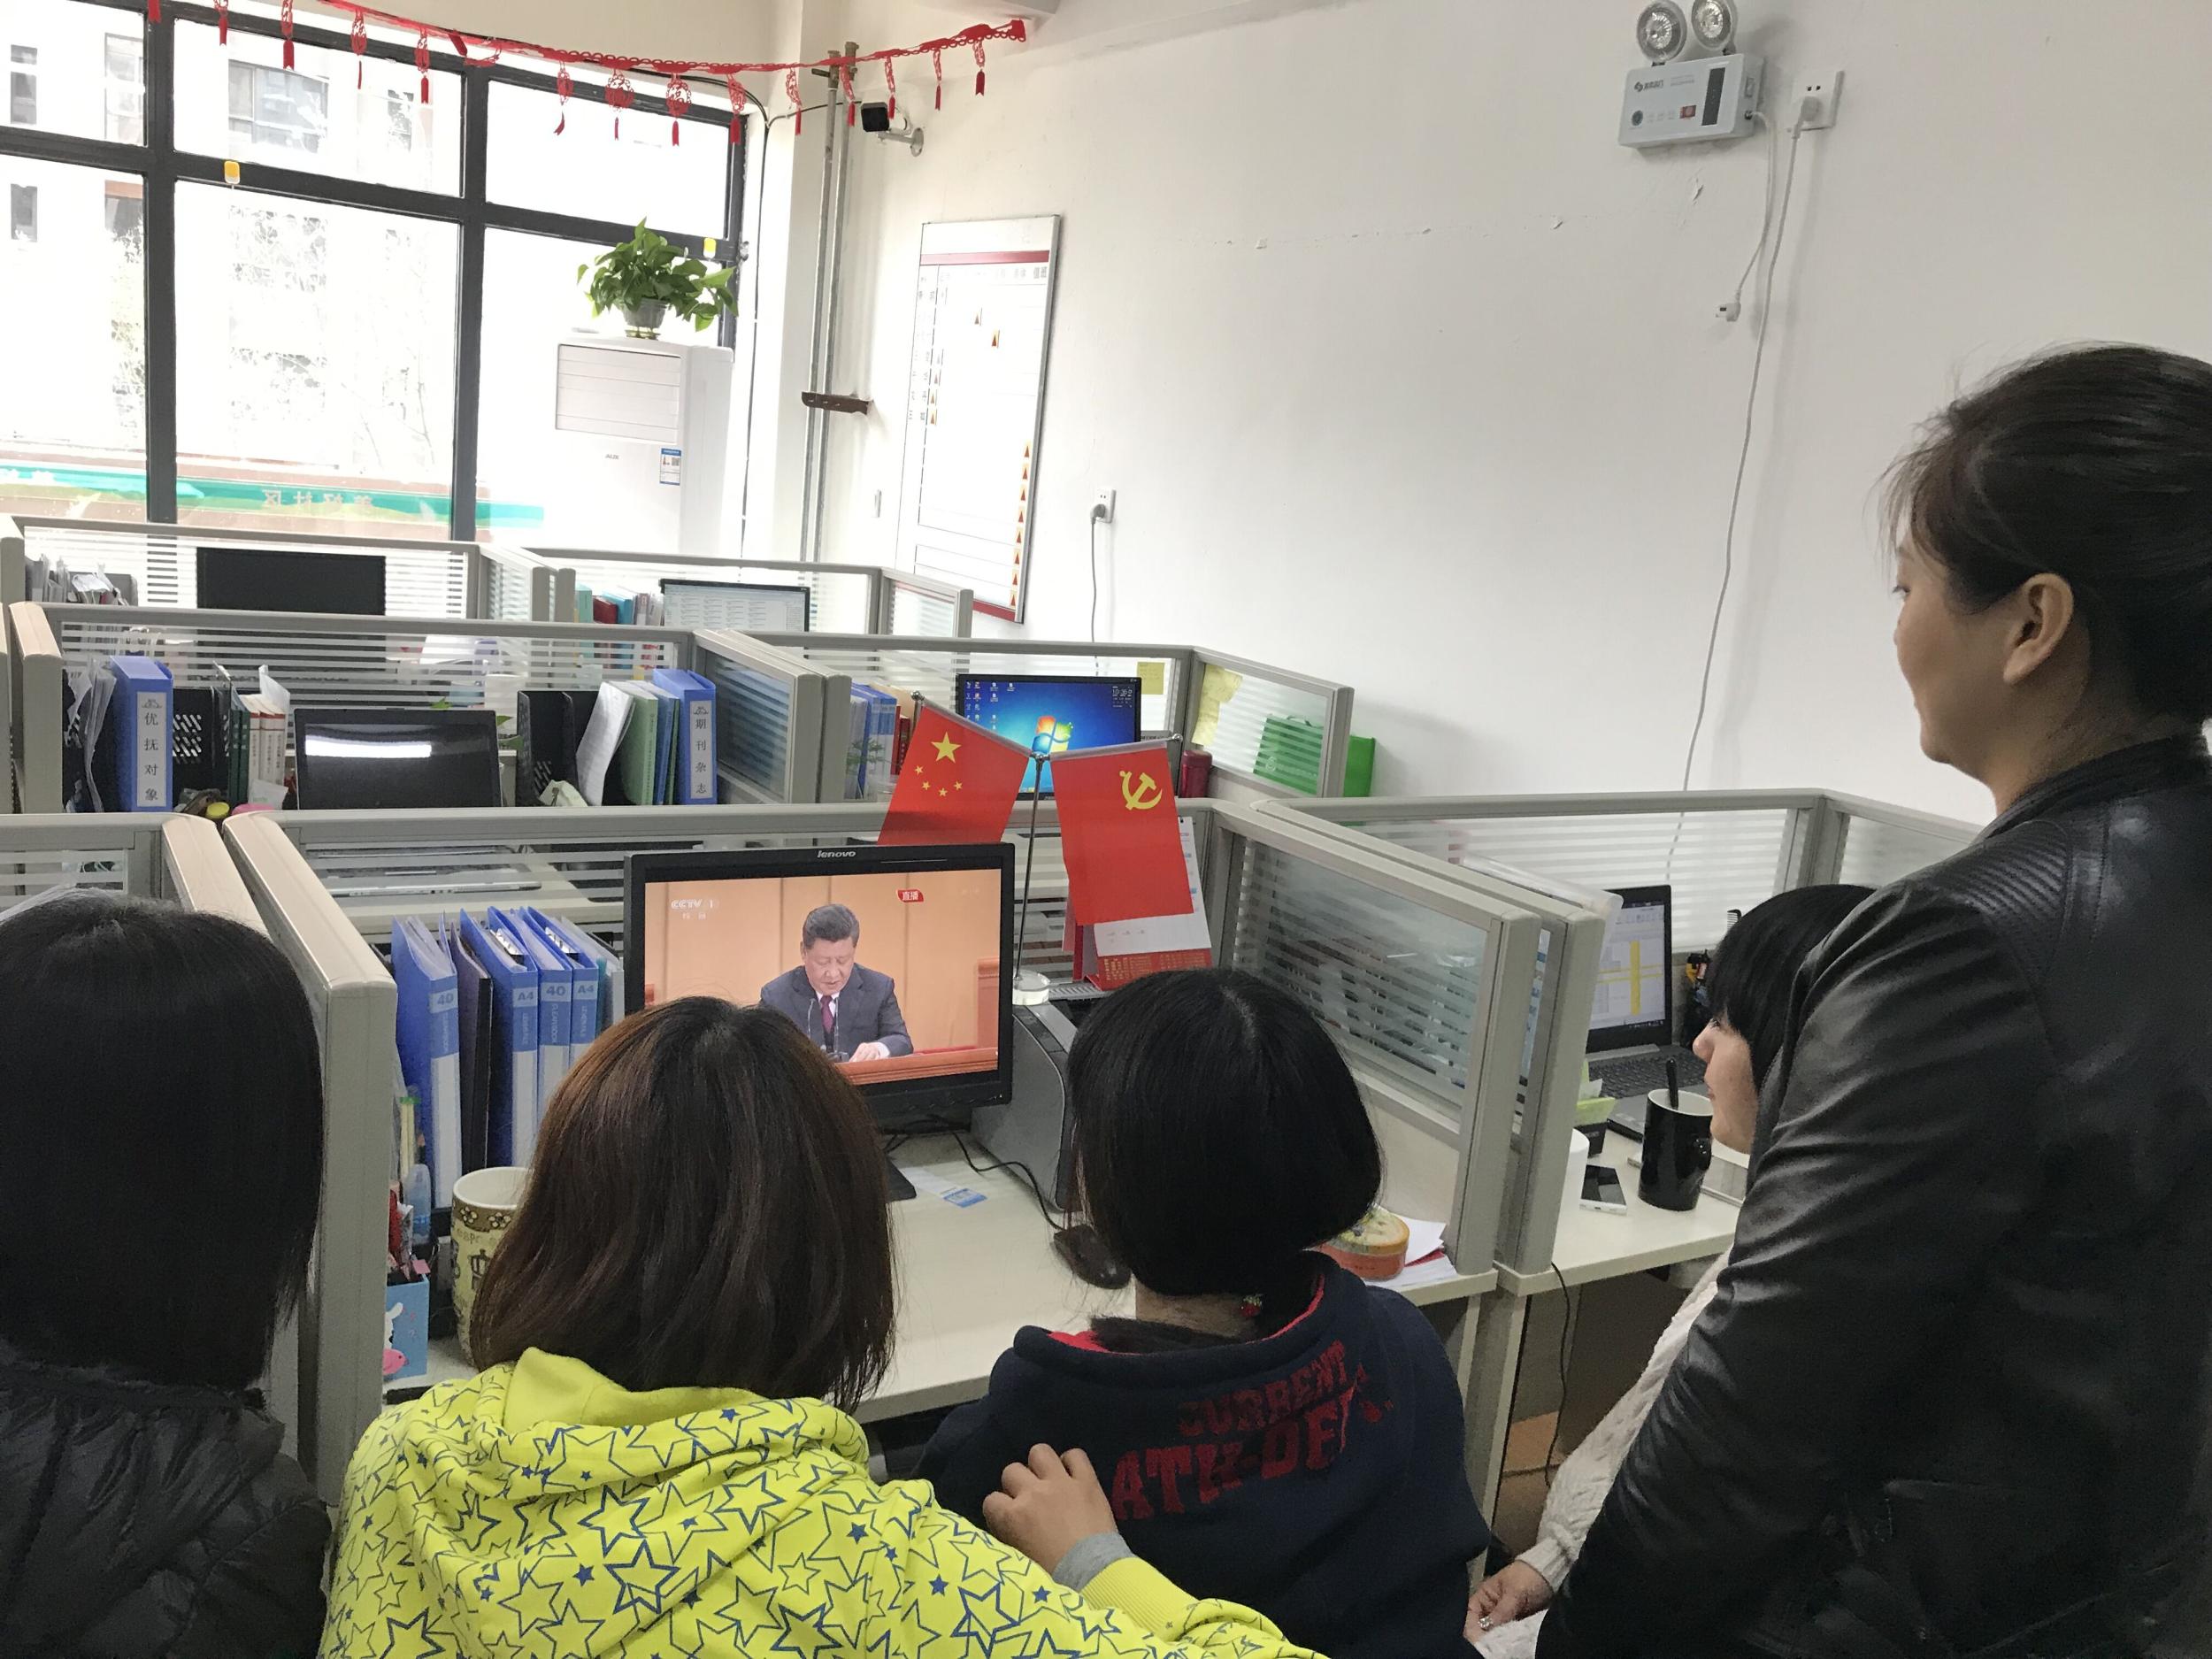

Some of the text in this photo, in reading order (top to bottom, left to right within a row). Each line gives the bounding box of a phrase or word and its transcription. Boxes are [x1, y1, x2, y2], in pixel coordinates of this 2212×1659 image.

[144, 711, 159, 802] 优抚对象
[695, 718, 708, 795] 期刊杂志
[546, 985, 566, 997] 40
[577, 985, 595, 995] A4
[436, 993, 454, 1006] 40
[517, 991, 534, 1002] A4
